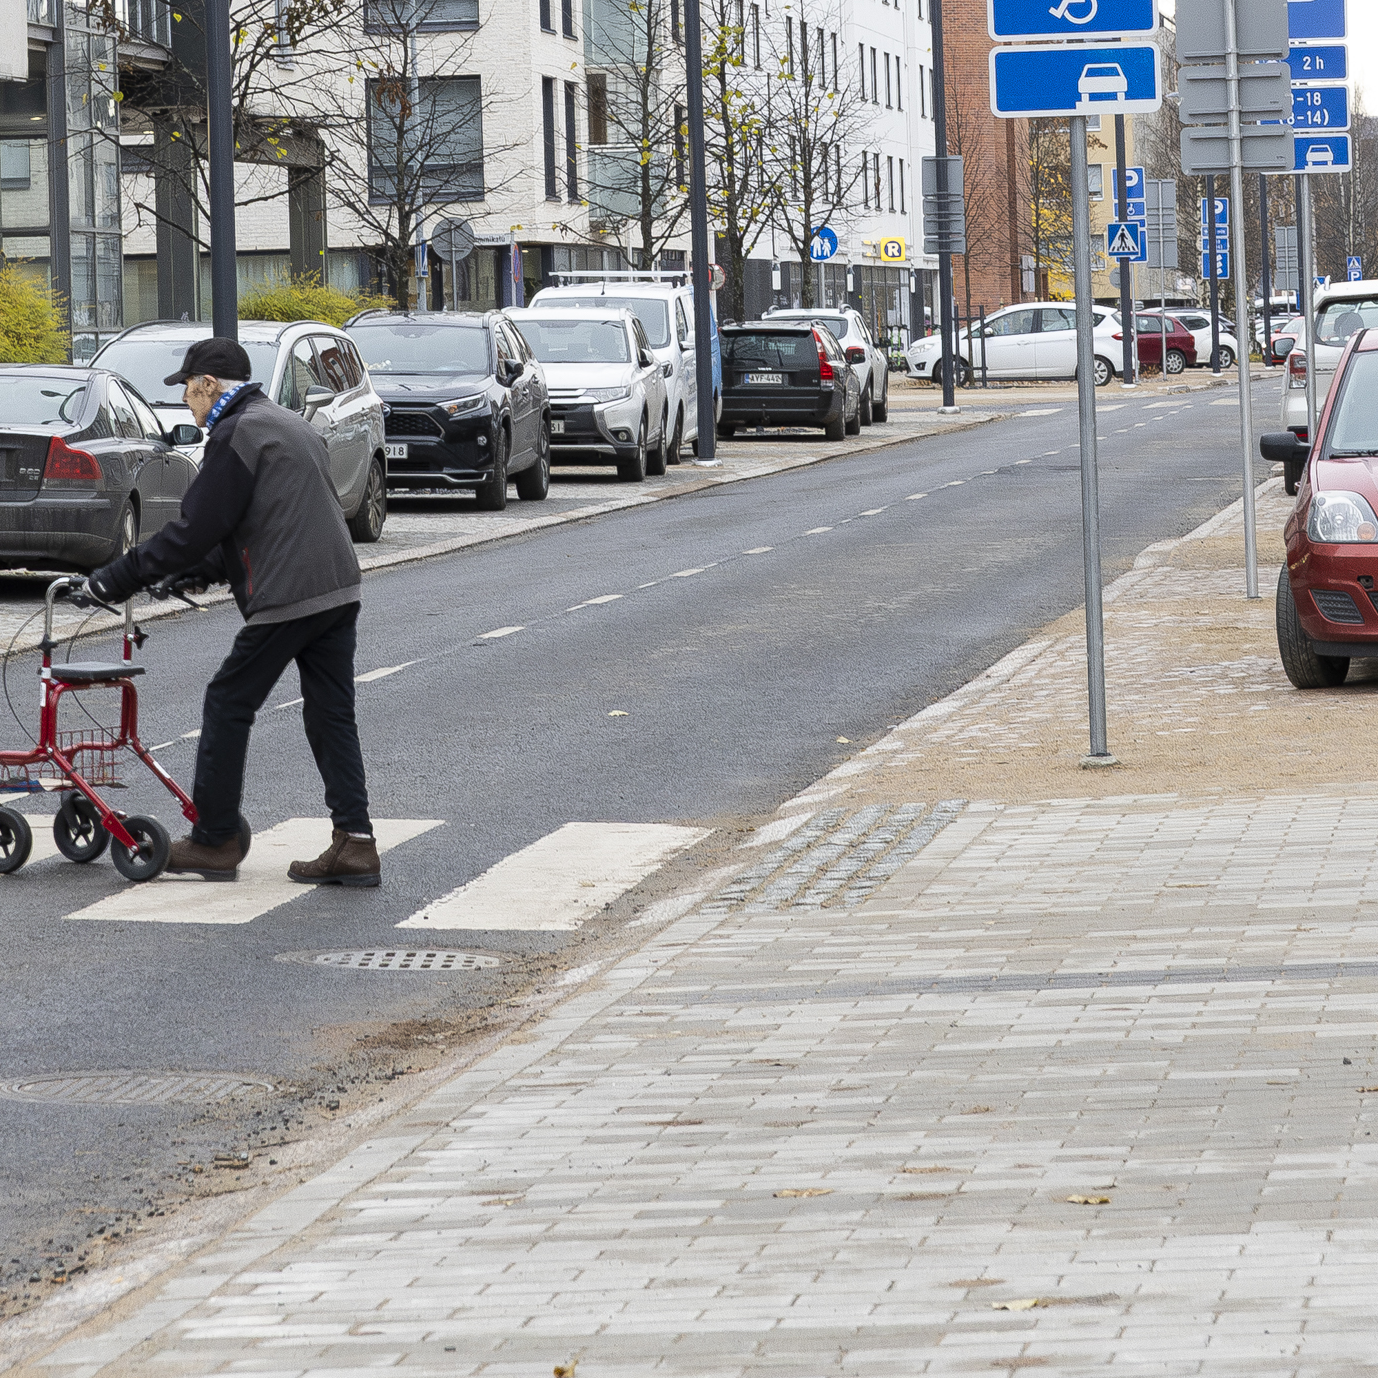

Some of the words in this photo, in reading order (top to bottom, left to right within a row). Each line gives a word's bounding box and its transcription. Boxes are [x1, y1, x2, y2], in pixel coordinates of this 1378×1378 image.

[1303, 56, 1312, 70] 2
[1316, 56, 1324, 70] h
[1279, 108, 1329, 126] 8-14)
[887, 243, 900, 257] R
[1351, 272, 1360, 282] P
